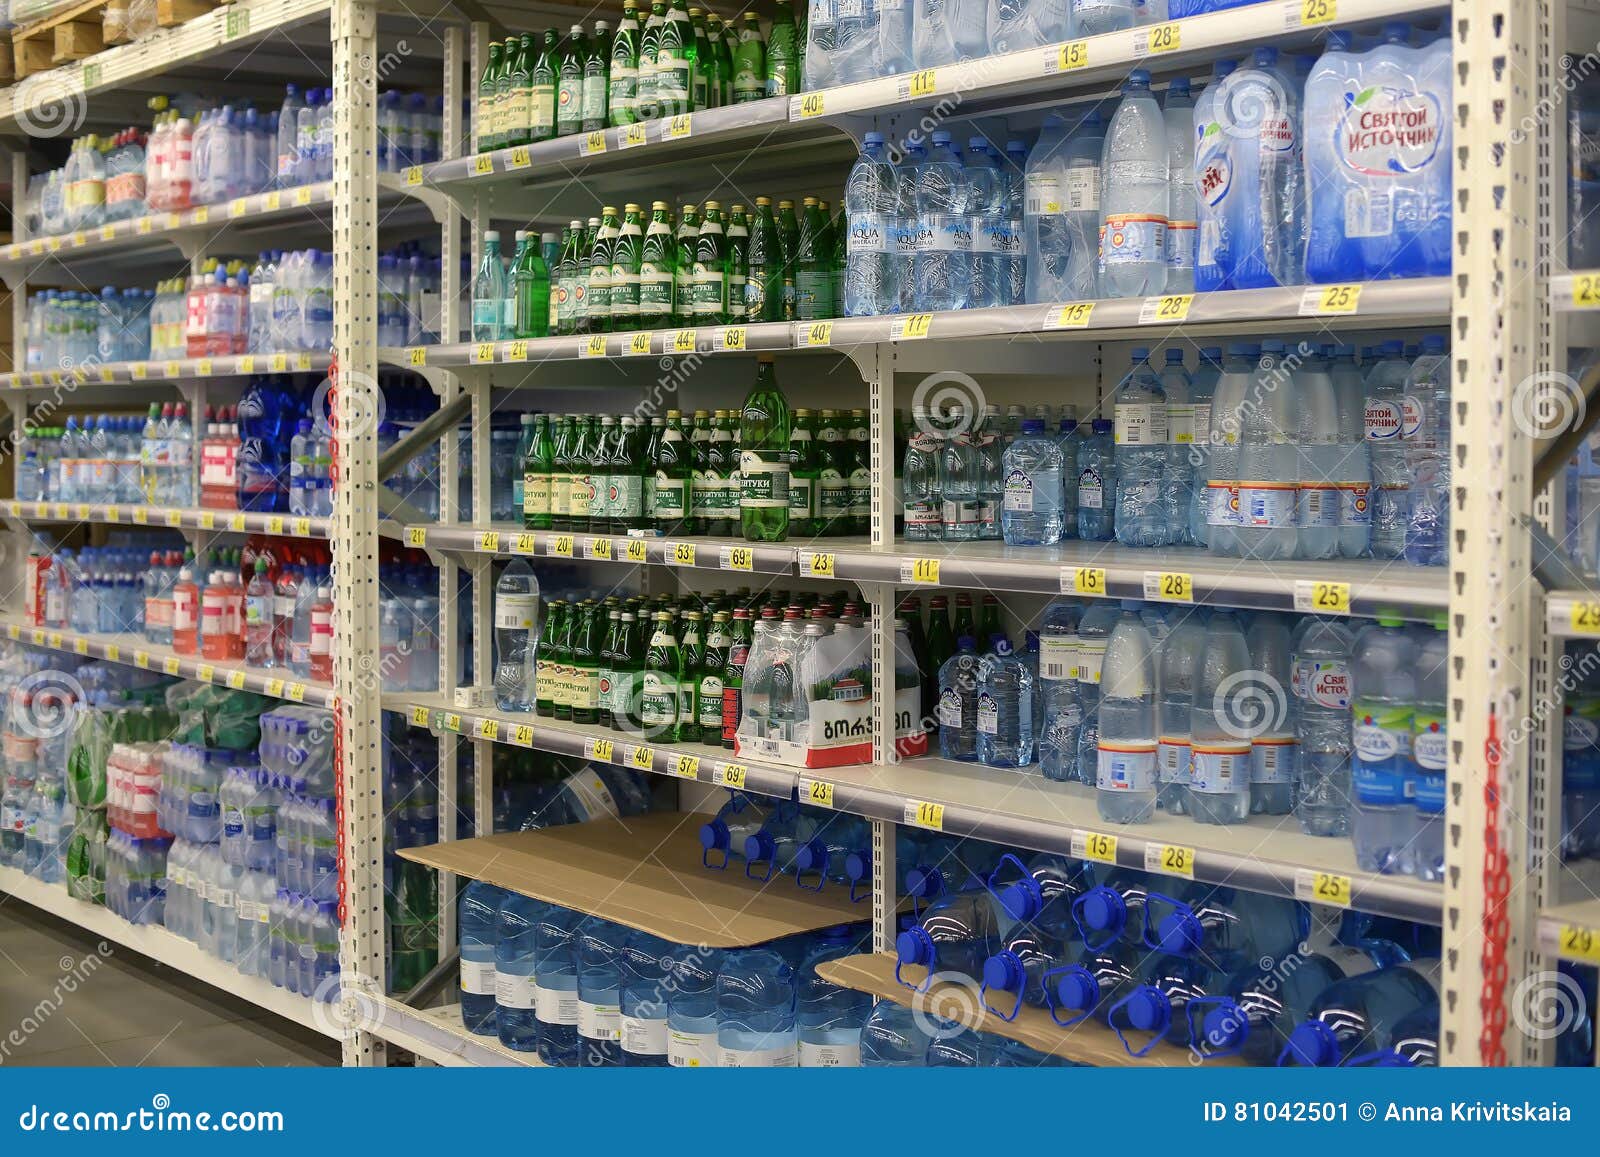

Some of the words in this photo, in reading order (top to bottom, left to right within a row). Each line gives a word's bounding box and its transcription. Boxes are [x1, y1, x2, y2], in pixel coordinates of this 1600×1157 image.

[1306, 0, 1327, 19] 25
[1153, 26, 1172, 48] 28
[1062, 44, 1080, 65] 15
[913, 71, 928, 91] 11
[804, 95, 818, 112] 40
[673, 118, 685, 132] 44
[1360, 105, 1427, 129] СВЯТОЙ
[589, 133, 600, 147] 40
[629, 126, 640, 140] 40
[1349, 128, 1435, 153] ИСТОЧНИК
[478, 157, 488, 170] 21
[515, 151, 525, 163] 21
[1326, 287, 1350, 306] 25
[1064, 304, 1084, 321] 15
[1159, 297, 1182, 315] 28
[909, 316, 923, 332] 11
[677, 332, 689, 347] 44
[726, 329, 740, 346] 69
[811, 324, 826, 341] 40
[513, 343, 523, 356] 21
[590, 337, 601, 350] 40
[634, 335, 645, 349] 40
[412, 350, 422, 361] 21
[480, 345, 490, 358] 21
[1365, 419, 1398, 427] ТОЧНИК
[412, 530, 421, 543] 21
[484, 533, 494, 546] 21
[520, 534, 530, 548] 21
[557, 537, 568, 552] 20
[595, 540, 606, 555] 40
[629, 541, 641, 556] 40
[677, 544, 689, 560] 53
[732, 549, 746, 565] 69
[814, 553, 828, 570] 23
[917, 560, 930, 577] 11
[1080, 569, 1097, 588] 15
[1165, 575, 1183, 595] 28
[1318, 586, 1339, 606] 25
[416, 708, 425, 723] 21
[483, 720, 494, 734] 21
[517, 725, 528, 740] 21
[824, 709, 911, 740] ბორი
[596, 739, 608, 754] 31
[636, 748, 648, 763] 40
[679, 757, 692, 773] 57
[726, 767, 740, 783] 69
[812, 781, 826, 800] 23
[921, 802, 934, 822] 11
[1090, 836, 1107, 855] 15
[1166, 848, 1185, 867] 28
[1318, 874, 1340, 896] 25
[1566, 928, 1592, 952] 29
